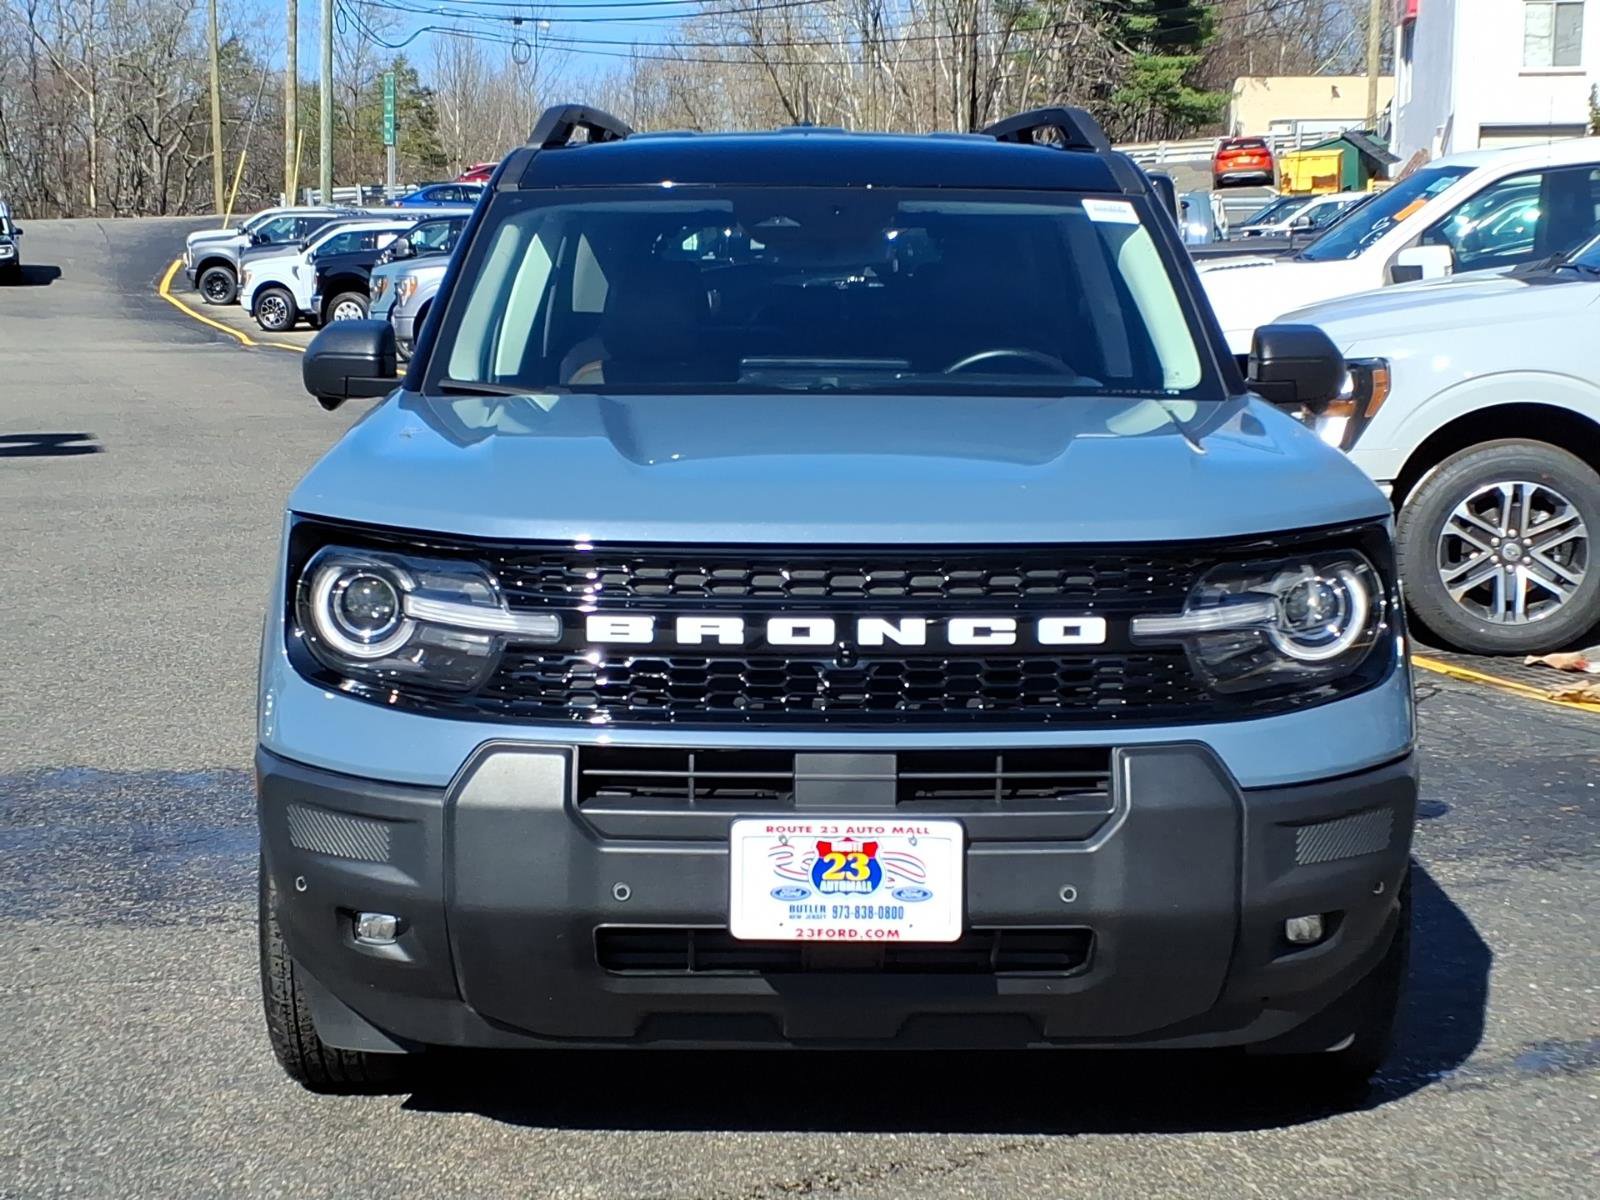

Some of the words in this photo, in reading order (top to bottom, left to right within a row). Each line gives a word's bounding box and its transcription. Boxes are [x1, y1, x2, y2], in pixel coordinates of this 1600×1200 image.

[585, 614, 1107, 647] BRONCO
[766, 825, 813, 834] ROUTE
[820, 826, 839, 834] 23
[846, 826, 885, 835] AUTO
[892, 826, 930, 835] MALL
[822, 852, 871, 881] 23
[789, 904, 826, 913] BUTLER
[832, 905, 904, 920] 973-838-0800
[795, 928, 900, 939] 23FORD.COM
